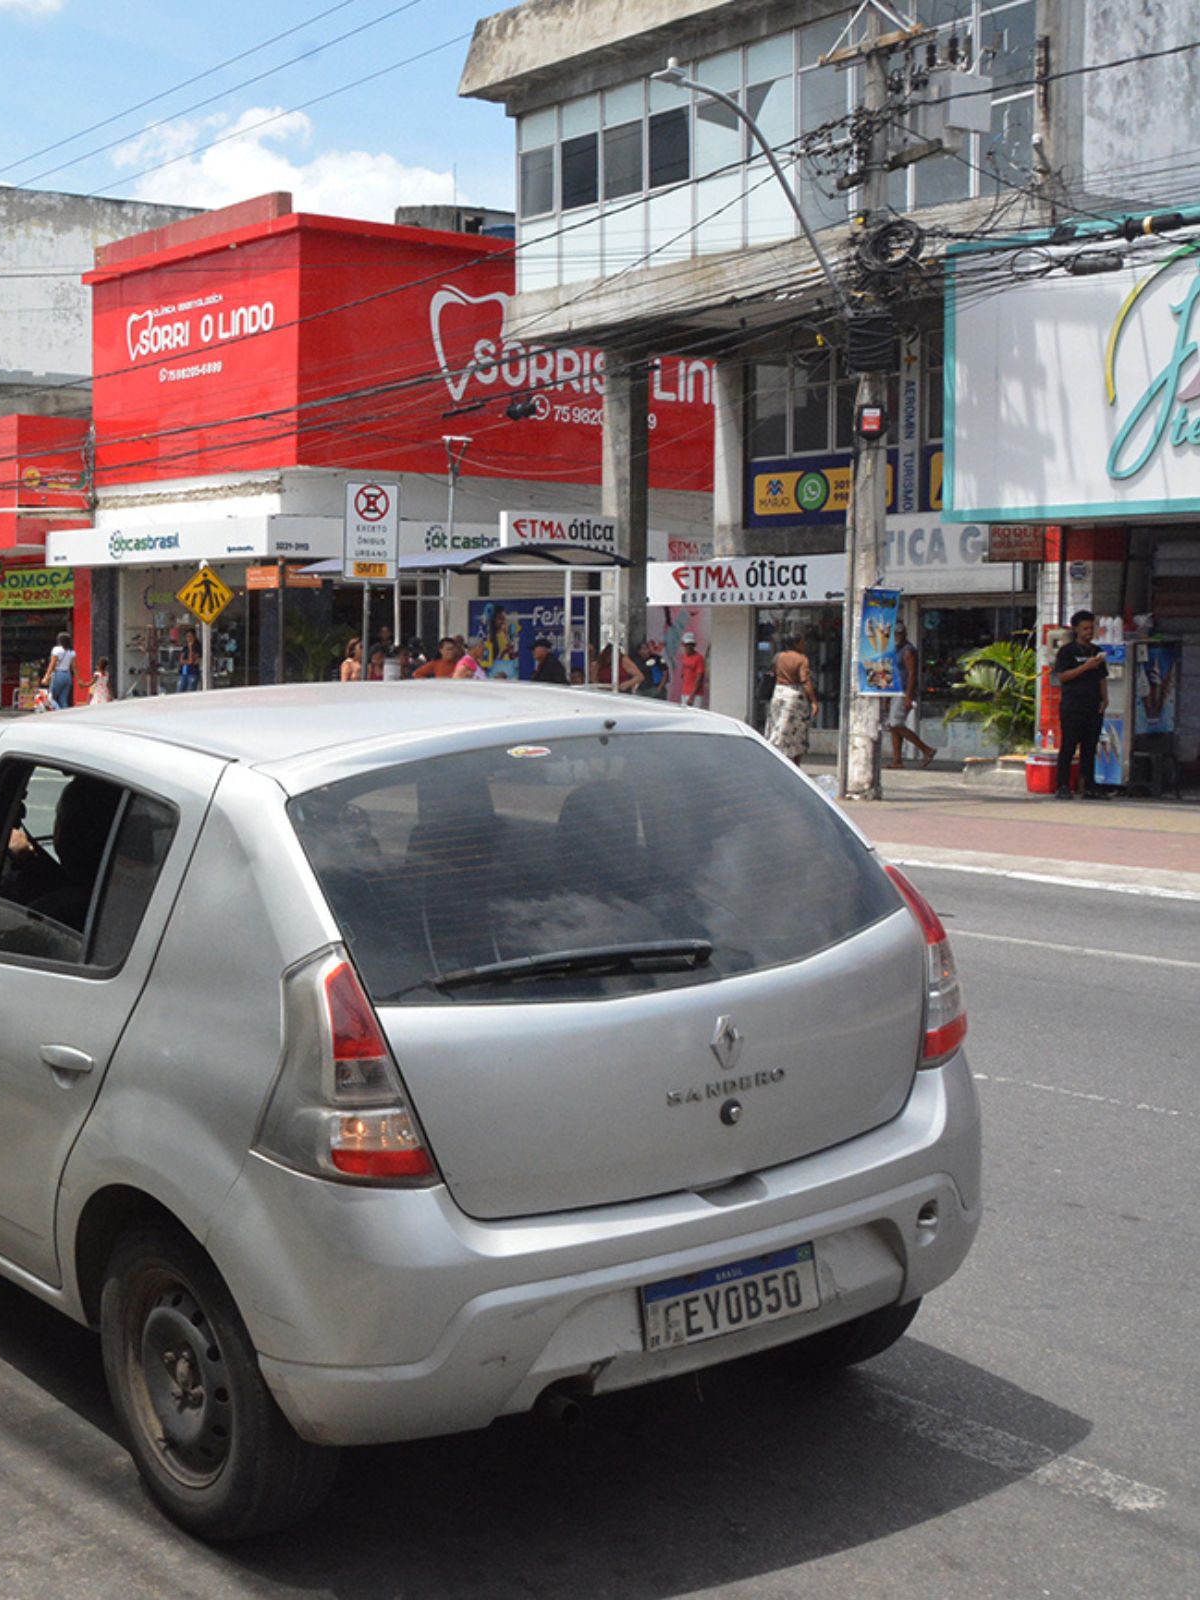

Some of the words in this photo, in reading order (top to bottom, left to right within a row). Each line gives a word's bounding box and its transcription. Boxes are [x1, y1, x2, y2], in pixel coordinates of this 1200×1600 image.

[139, 320, 190, 356] SORRI
[218, 301, 275, 340] LINDO
[473, 338, 606, 395] SORRIS
[653, 358, 717, 405] LIN
[902, 452, 914, 511] TURISMO
[356, 524, 388, 534] EXCETO
[512, 518, 566, 539] ETMA
[568, 517, 615, 542] ótica
[354, 550, 388, 558] URBANO
[883, 527, 949, 568] TICA
[357, 562, 385, 573] SMTT
[671, 564, 739, 590] ETMA
[745, 560, 808, 588] ótica
[681, 589, 809, 604] ESPECIALIZADA
[666, 1067, 786, 1108] SANDERO
